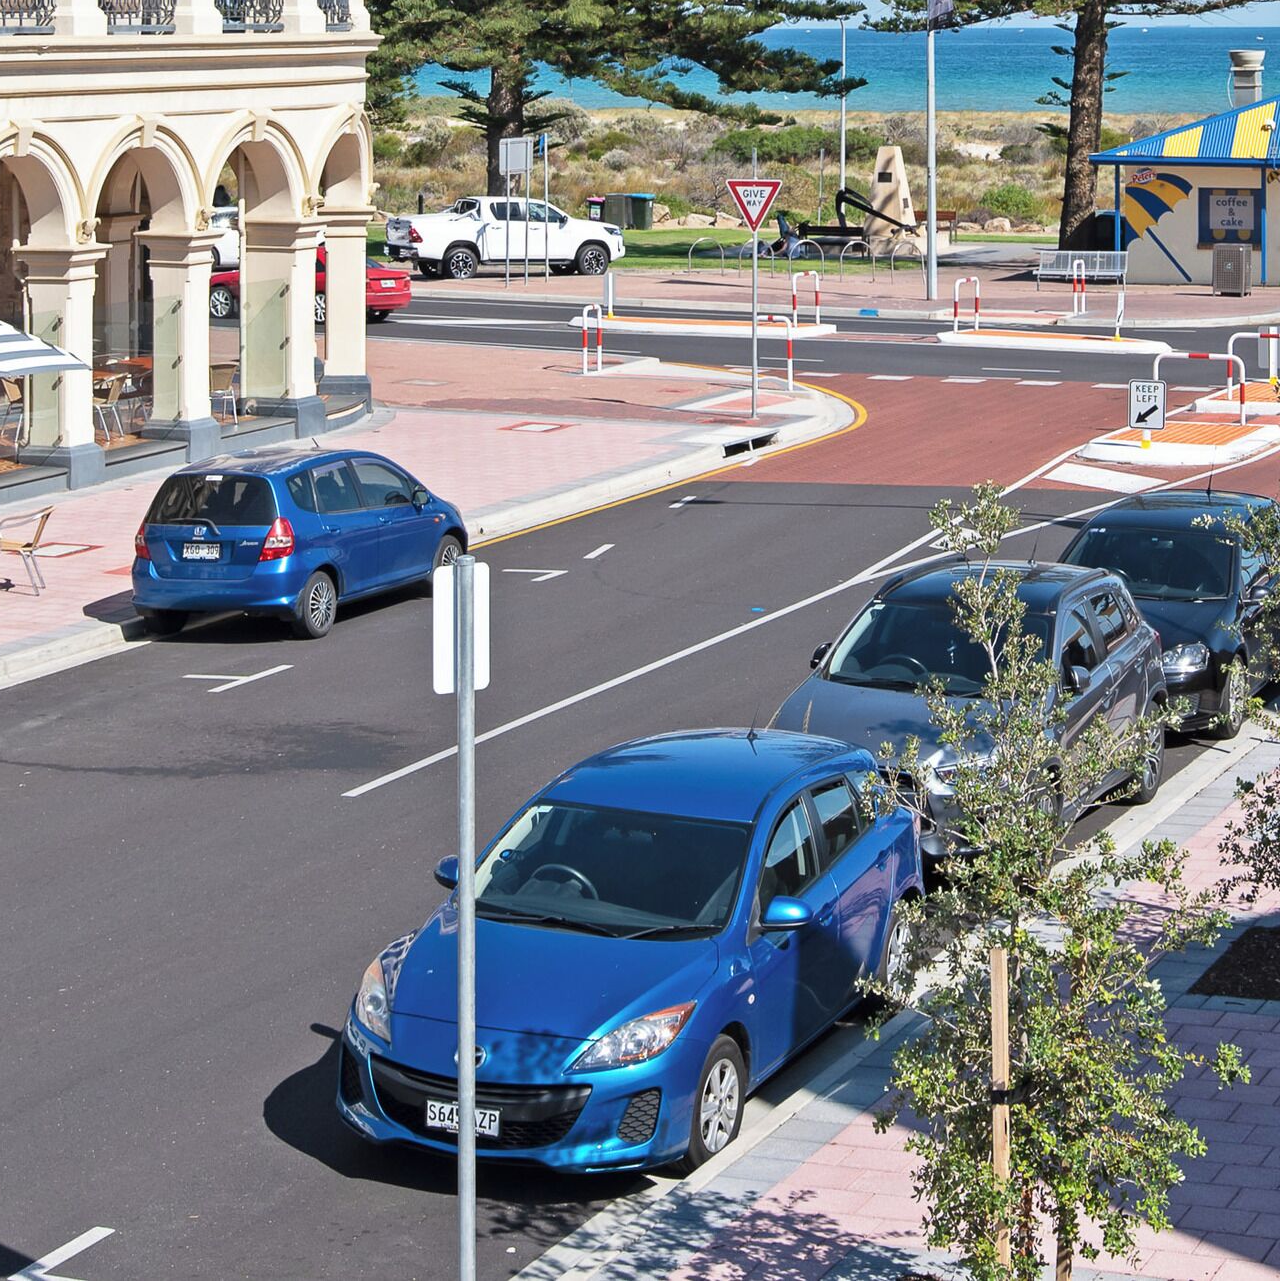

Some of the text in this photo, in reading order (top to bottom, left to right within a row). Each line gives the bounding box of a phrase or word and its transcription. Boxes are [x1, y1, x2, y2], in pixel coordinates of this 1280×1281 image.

[1132, 171, 1157, 185] Peters
[742, 189, 766, 198] GIVE
[746, 199, 762, 207] WAY
[1215, 196, 1248, 207] coffee
[1228, 207, 1235, 216] &
[1220, 217, 1243, 226] cake
[1135, 384, 1159, 393] KEEP
[1136, 394, 1158, 403] LEFT
